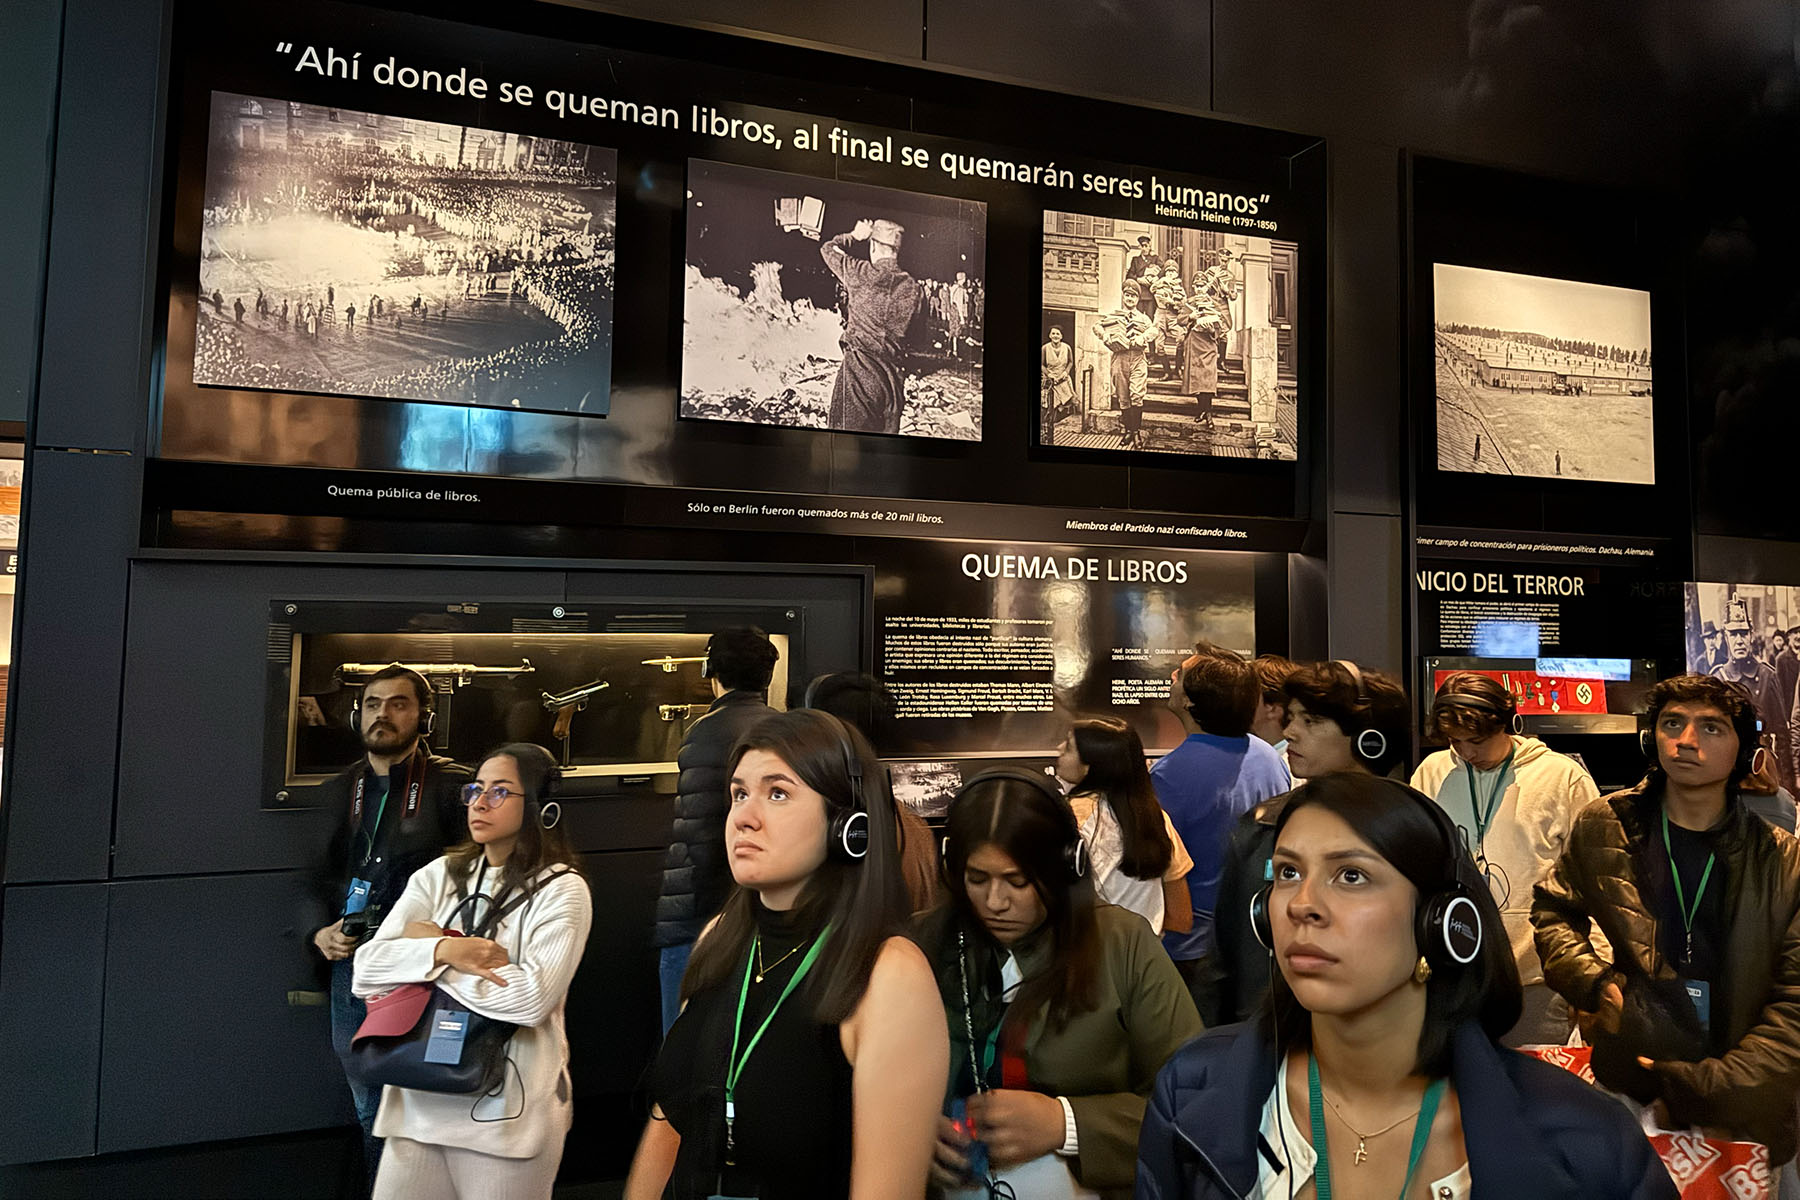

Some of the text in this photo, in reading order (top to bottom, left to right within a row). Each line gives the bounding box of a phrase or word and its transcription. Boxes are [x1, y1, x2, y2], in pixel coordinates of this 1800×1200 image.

[372, 55, 488, 99] donde
[498, 81, 534, 106] se
[545, 89, 679, 129] queman
[691, 104, 782, 150] libros,
[792, 122, 818, 151] al
[827, 126, 892, 163] final
[900, 145, 929, 168] se
[939, 151, 1074, 189] quemarán
[1082, 172, 1143, 199] seres
[1155, 203, 1277, 231] Heinrich Heine (1797-1856)
[327, 484, 481, 502] Quema pública de libros.
[687, 502, 710, 512] Sólo
[728, 504, 758, 514] Berlín
[760, 504, 795, 515] fueron
[797, 508, 848, 519] quemados
[849, 509, 869, 519] más
[870, 510, 884, 520] de
[884, 511, 898, 521] 20
[898, 512, 915, 522] mil
[915, 512, 944, 524] libros.
[1065, 520, 1248, 538] Miembros del Partido nazi confiscando libros.
[1416, 536, 1434, 544] rimer
[1434, 538, 1458, 547] campo
[1458, 538, 1469, 547] de
[1469, 540, 1516, 549] concentración
[1516, 543, 1532, 551] para
[1532, 543, 1569, 552] prisioneros
[1623, 547, 1654, 556] Alemania.
[962, 554, 1187, 583] QUEMA DE LIBROS
[1415, 570, 1584, 596] NICIO DEL TERROR
